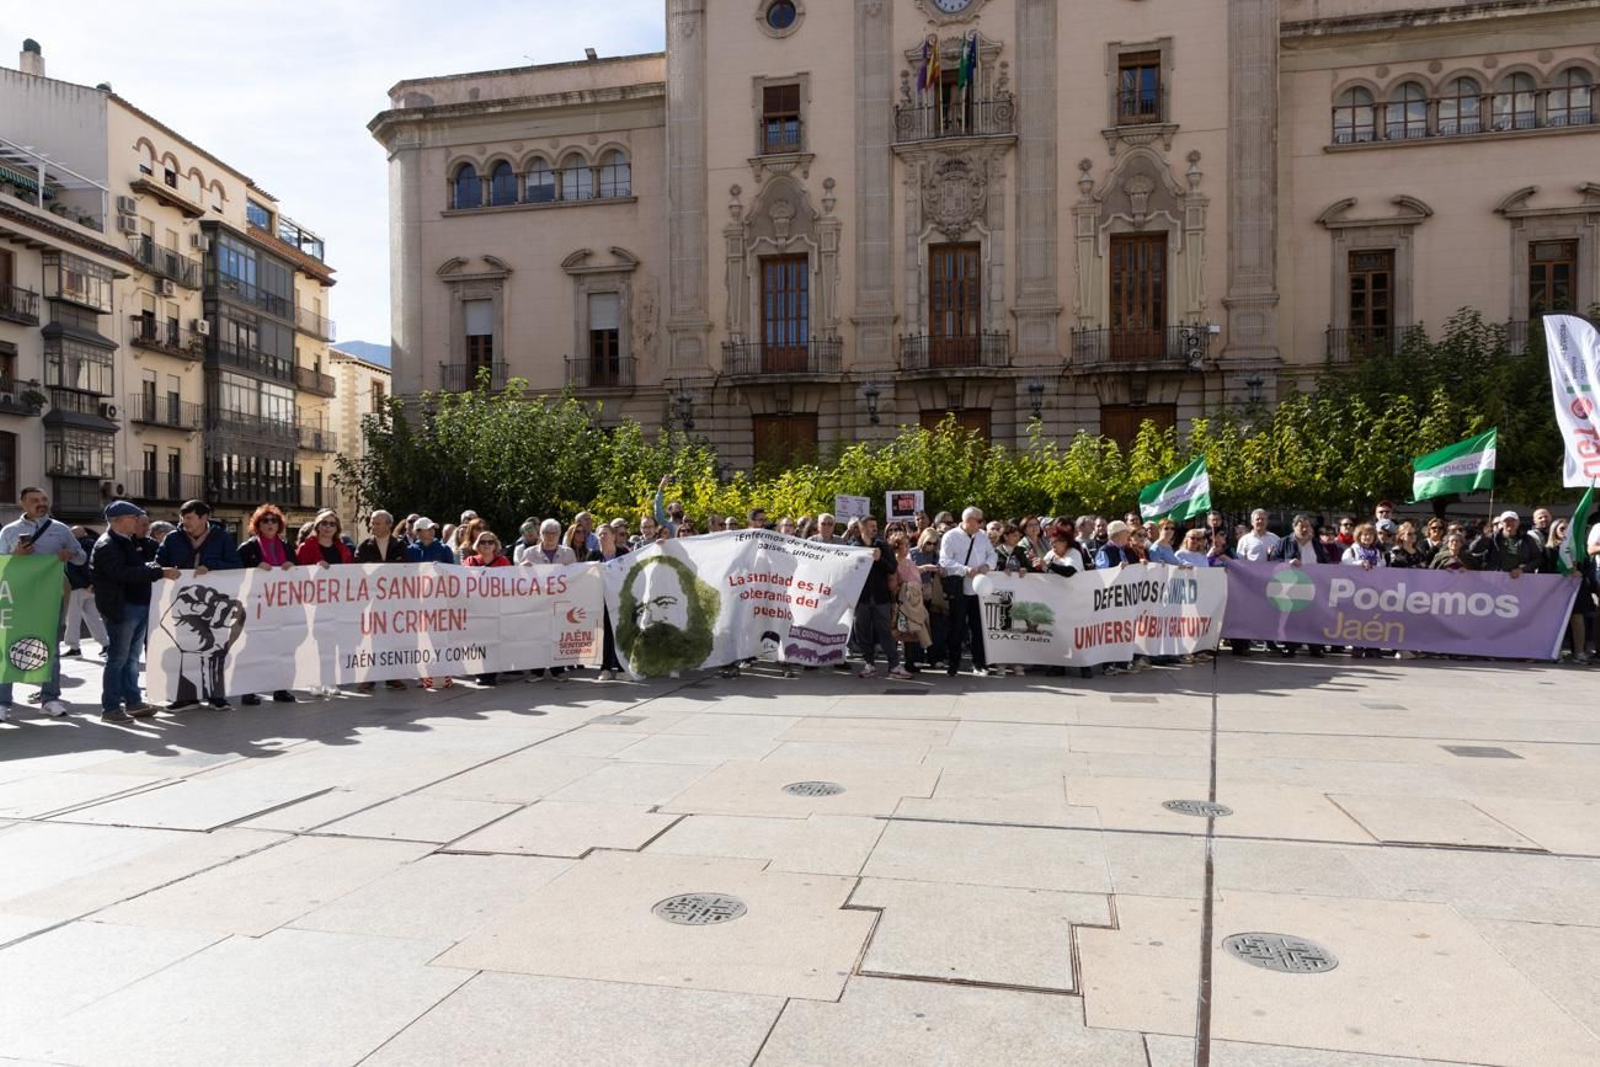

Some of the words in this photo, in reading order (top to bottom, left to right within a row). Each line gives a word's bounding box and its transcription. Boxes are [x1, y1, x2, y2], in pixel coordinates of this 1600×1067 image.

[257, 579, 340, 619] ¡VENDER
[346, 578, 369, 601] LA
[376, 574, 460, 600] SANIDAD
[466, 570, 541, 598] PÚBLICA
[546, 574, 567, 596] ES
[729, 575, 745, 587] La
[797, 580, 815, 591] es
[818, 582, 832, 596] la
[796, 595, 819, 609] del
[1328, 578, 1520, 619] Podemos
[361, 611, 387, 636] UN
[392, 608, 467, 634] CRIMEN!
[753, 605, 793, 621] pueblo
[560, 629, 592, 642] JAÉN
[1323, 611, 1405, 642] Jaén
[11, 646, 47, 663] PACMA
[346, 649, 376, 669] JAÉN
[380, 649, 431, 667] SENTIDO
[434, 649, 442, 662] Y
[445, 642, 487, 662] COMÚN
[559, 641, 592, 649] SENTIDO
